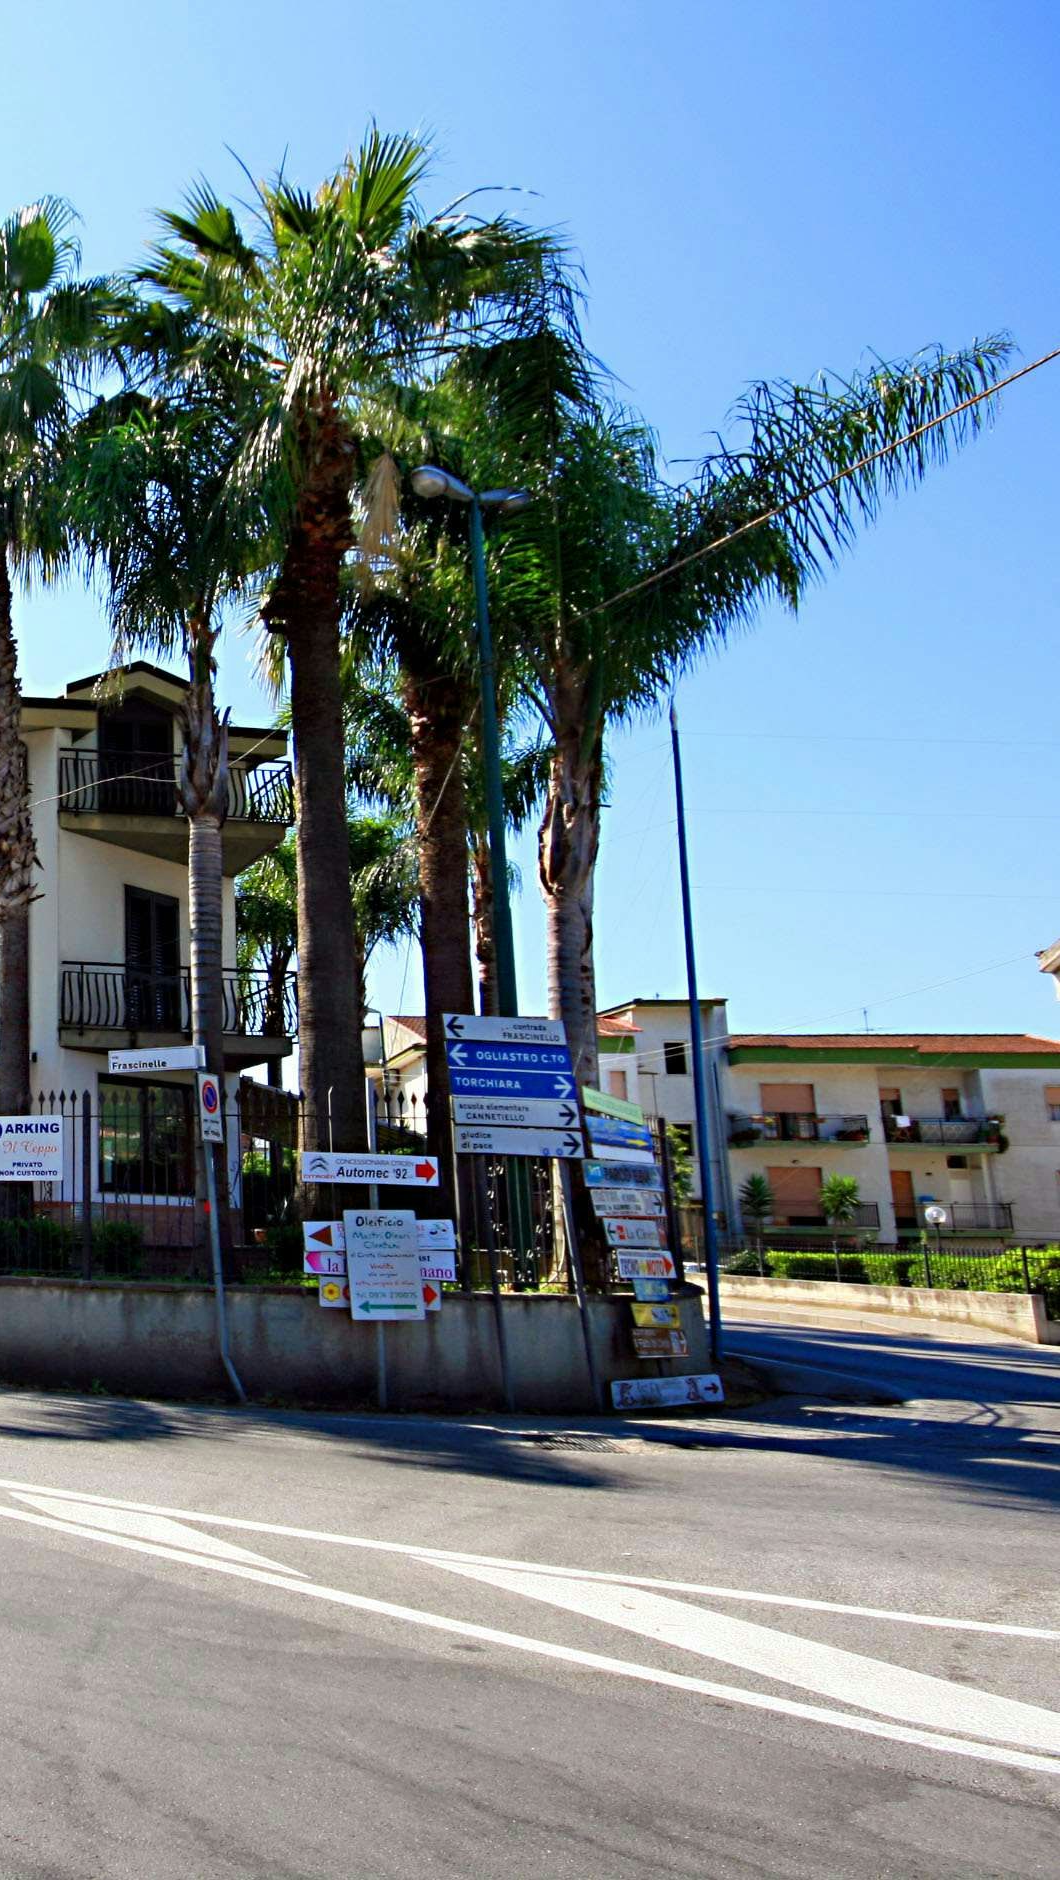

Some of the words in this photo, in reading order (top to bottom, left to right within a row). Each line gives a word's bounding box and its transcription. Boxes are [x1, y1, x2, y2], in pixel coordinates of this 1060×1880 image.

[502, 1032, 560, 1042] FRASCINELLO
[476, 1051, 538, 1063] OGLIASTRO
[541, 1054, 566, 1064] C.TO
[112, 1060, 167, 1070] Frascinelle
[455, 1077, 522, 1089] TORCHIARA
[466, 1112, 525, 1122] CANNETIELLO
[461, 1131, 492, 1141] giudice
[473, 1143, 493, 1151] pace
[336, 1166, 389, 1179] Automec
